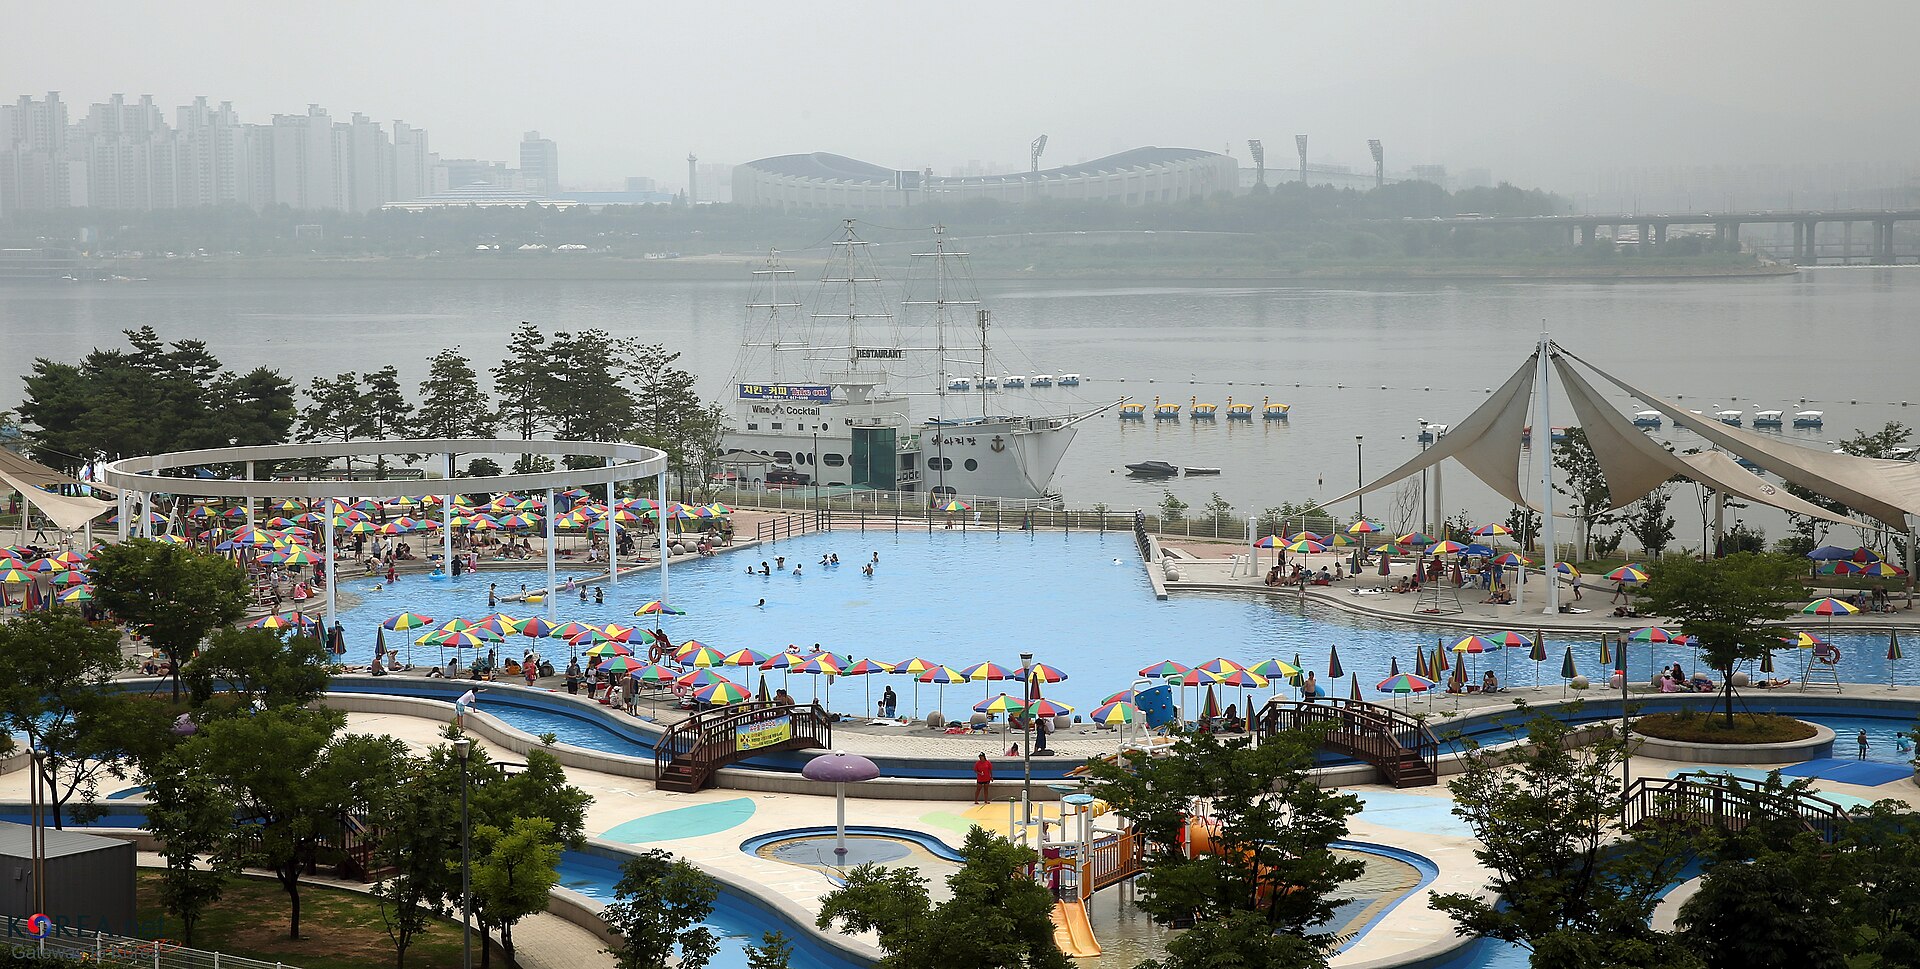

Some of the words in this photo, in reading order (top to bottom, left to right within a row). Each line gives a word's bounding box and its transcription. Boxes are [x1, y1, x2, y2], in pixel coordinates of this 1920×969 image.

[856, 349, 902, 359] RESTAURANT
[752, 405, 770, 414] Wine
[786, 406, 820, 416] Cocktail
